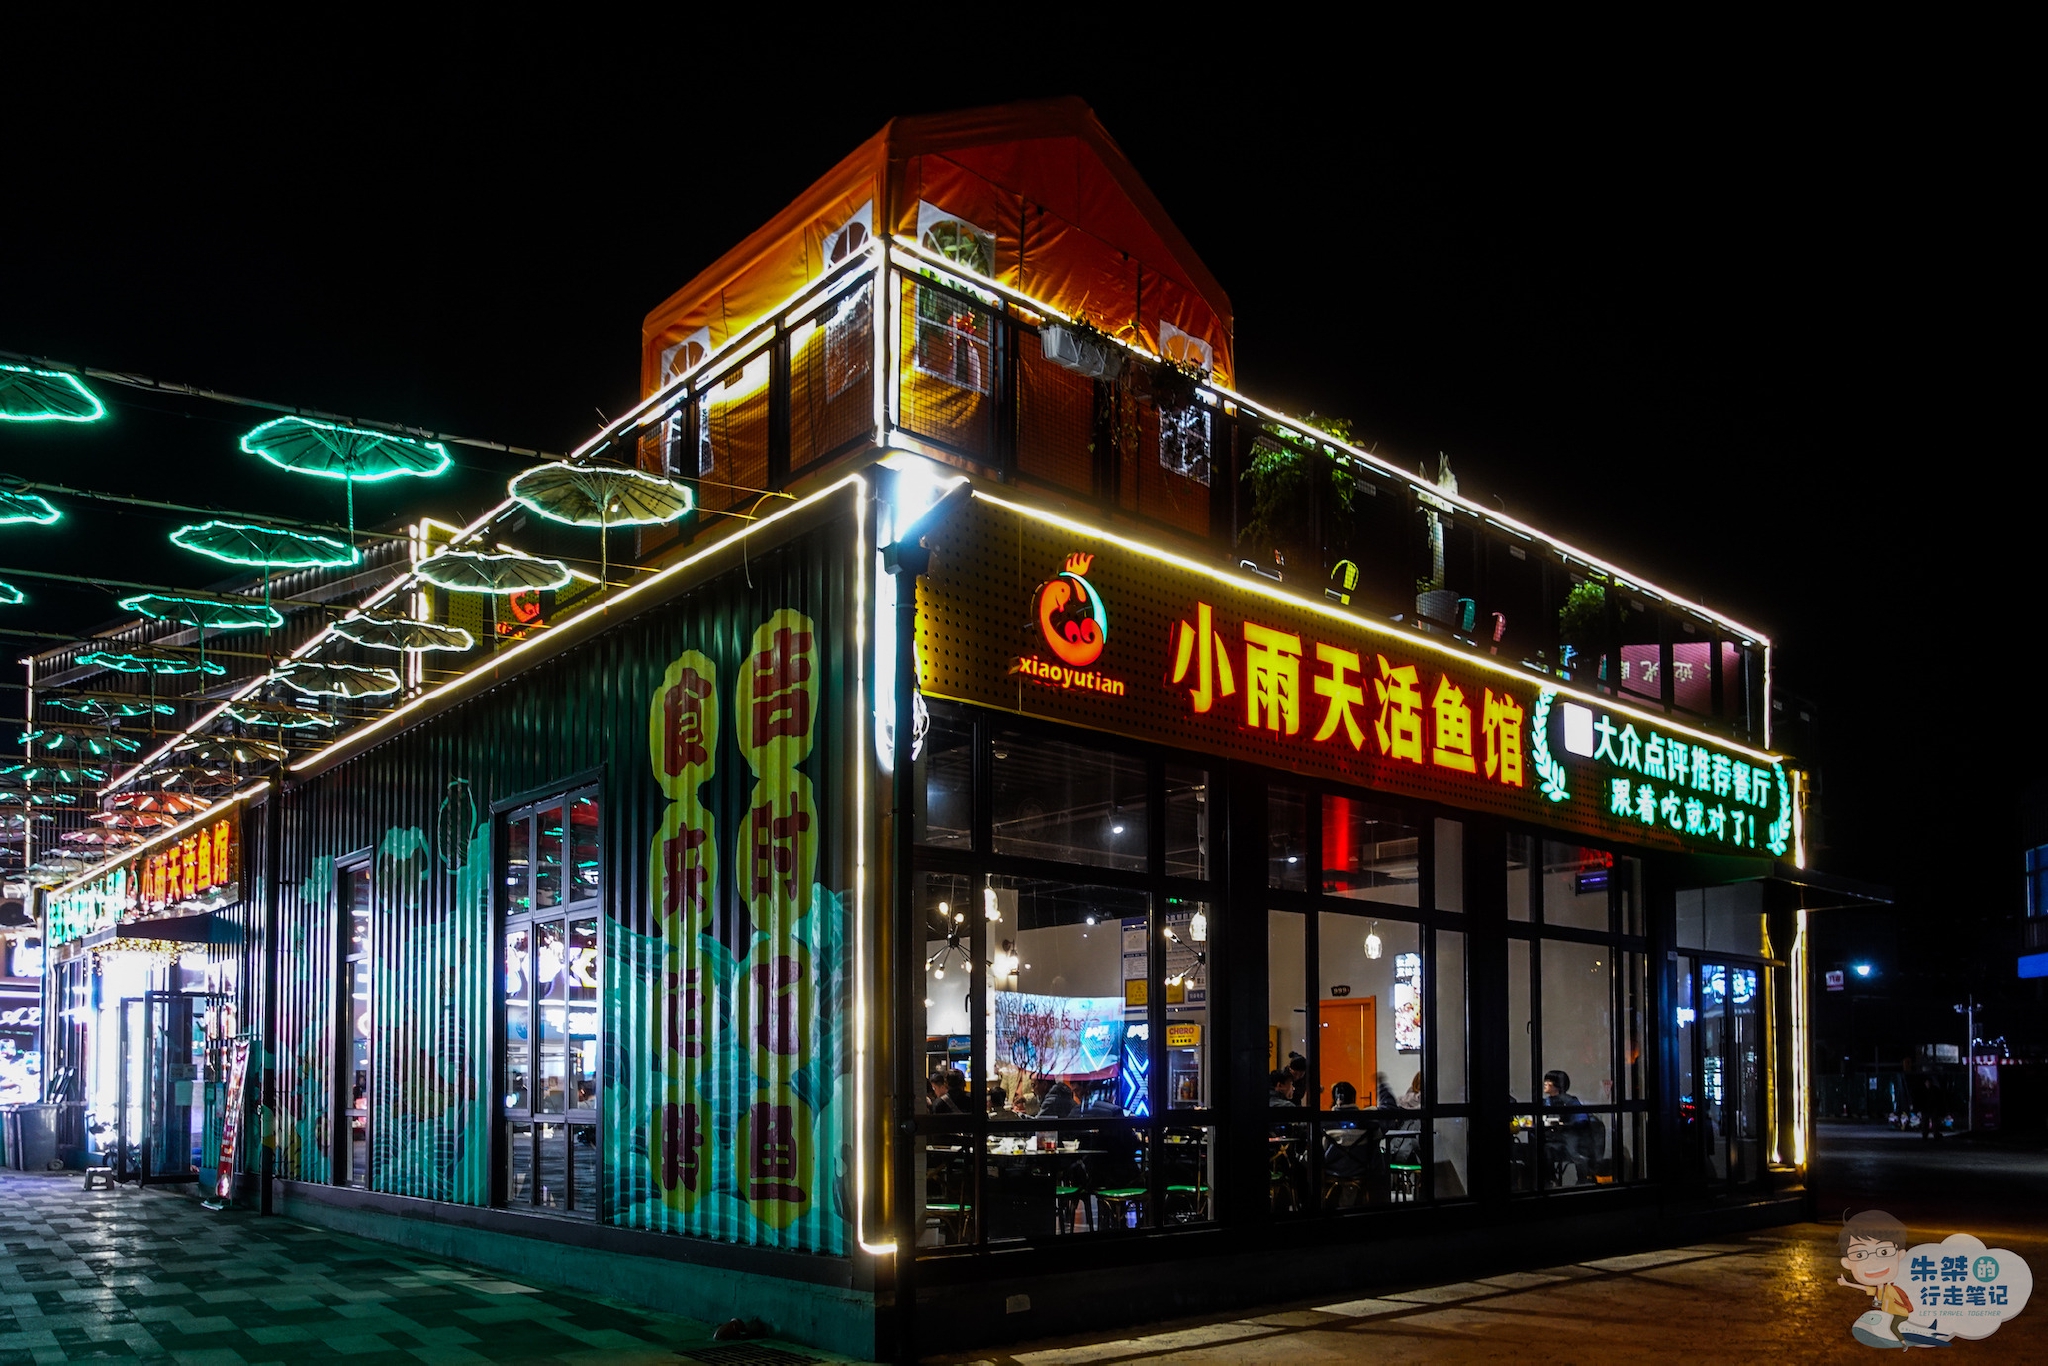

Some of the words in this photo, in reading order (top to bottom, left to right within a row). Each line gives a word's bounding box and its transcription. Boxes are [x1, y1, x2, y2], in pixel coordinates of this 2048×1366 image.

[1019, 655, 1126, 697] xiaoyutian
[1169, 600, 1525, 789] 小雨天活鱼馆
[1593, 714, 1772, 809] 大众点评推荐餐厅
